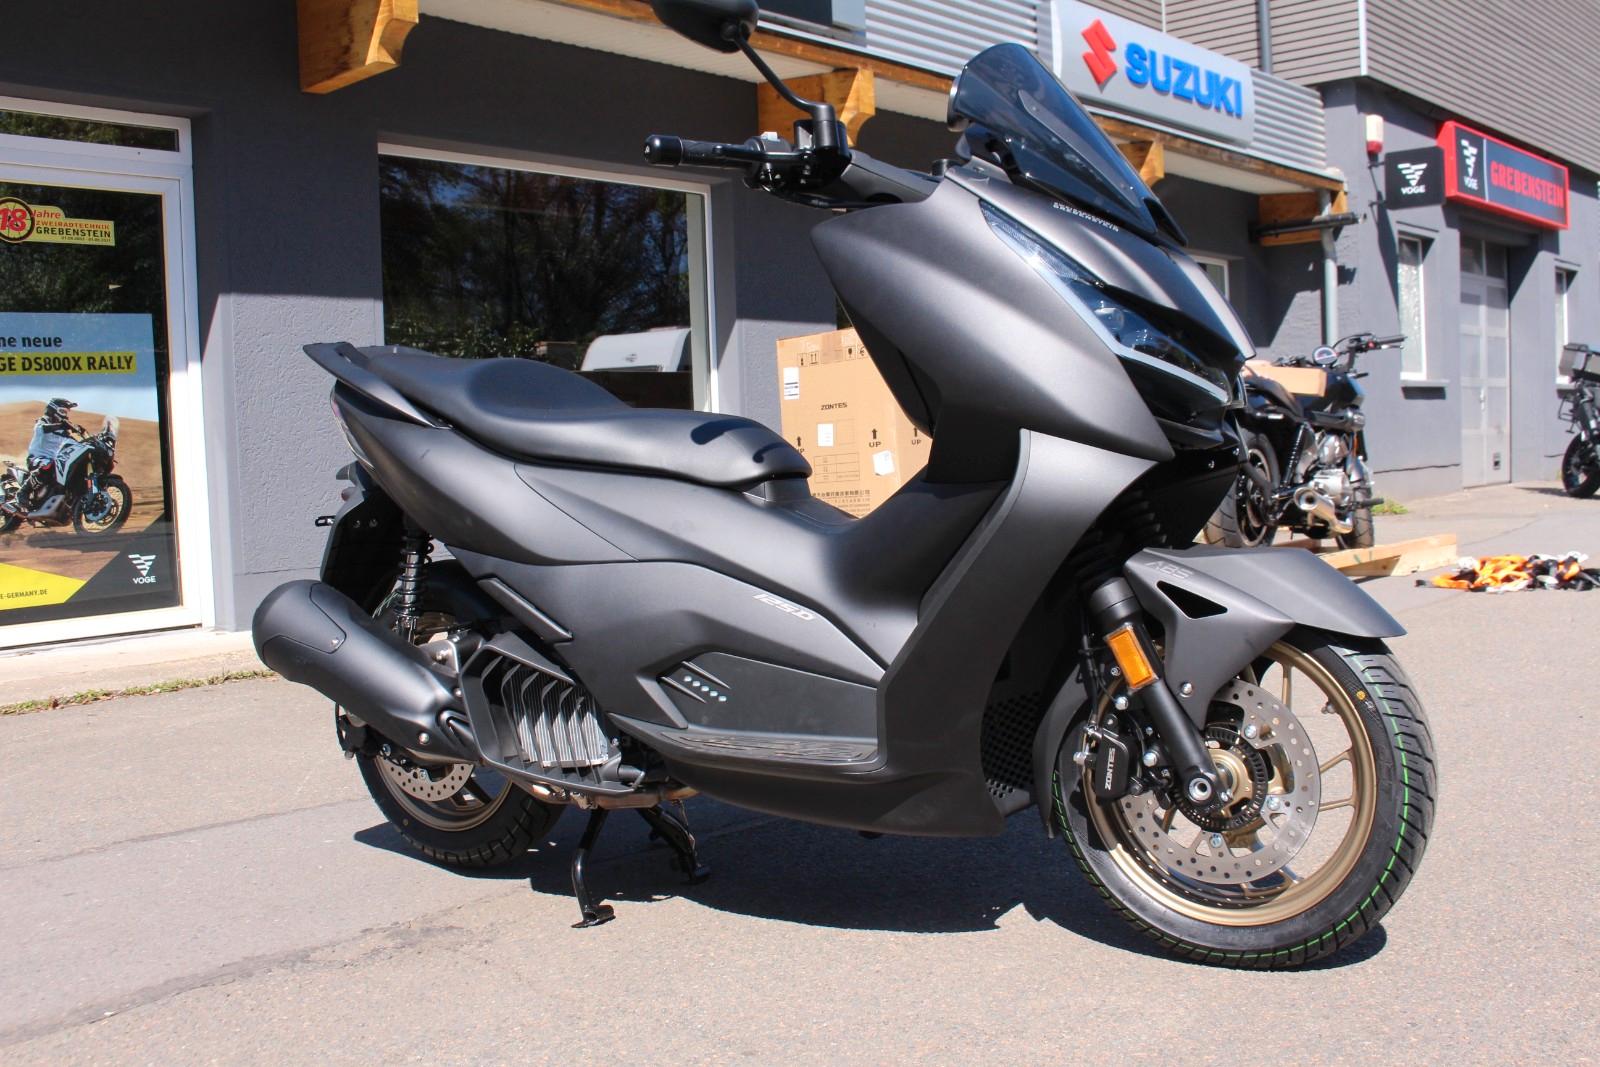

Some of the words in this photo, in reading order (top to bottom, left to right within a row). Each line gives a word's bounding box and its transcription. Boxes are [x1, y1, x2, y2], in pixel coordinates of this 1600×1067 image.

[1125, 42, 1243, 118] SUZUKI
[1464, 175, 1478, 190] VOGE
[1490, 160, 1564, 208] GREBENSTEIN
[1401, 185, 1426, 195] VOGE
[36, 220, 110, 230] ZWEIRADTECHNIK
[36, 226, 111, 238] GREBENSTEIN
[21, 336, 63, 348] neue
[21, 356, 83, 371] DS800X
[87, 355, 133, 370] RALLY
[820, 402, 848, 411] ZONTES
[911, 438, 922, 446] UP
[1144, 560, 1194, 579] ABS
[132, 576, 156, 584] VOGE
[1105, 748, 1116, 791] ZONTES
